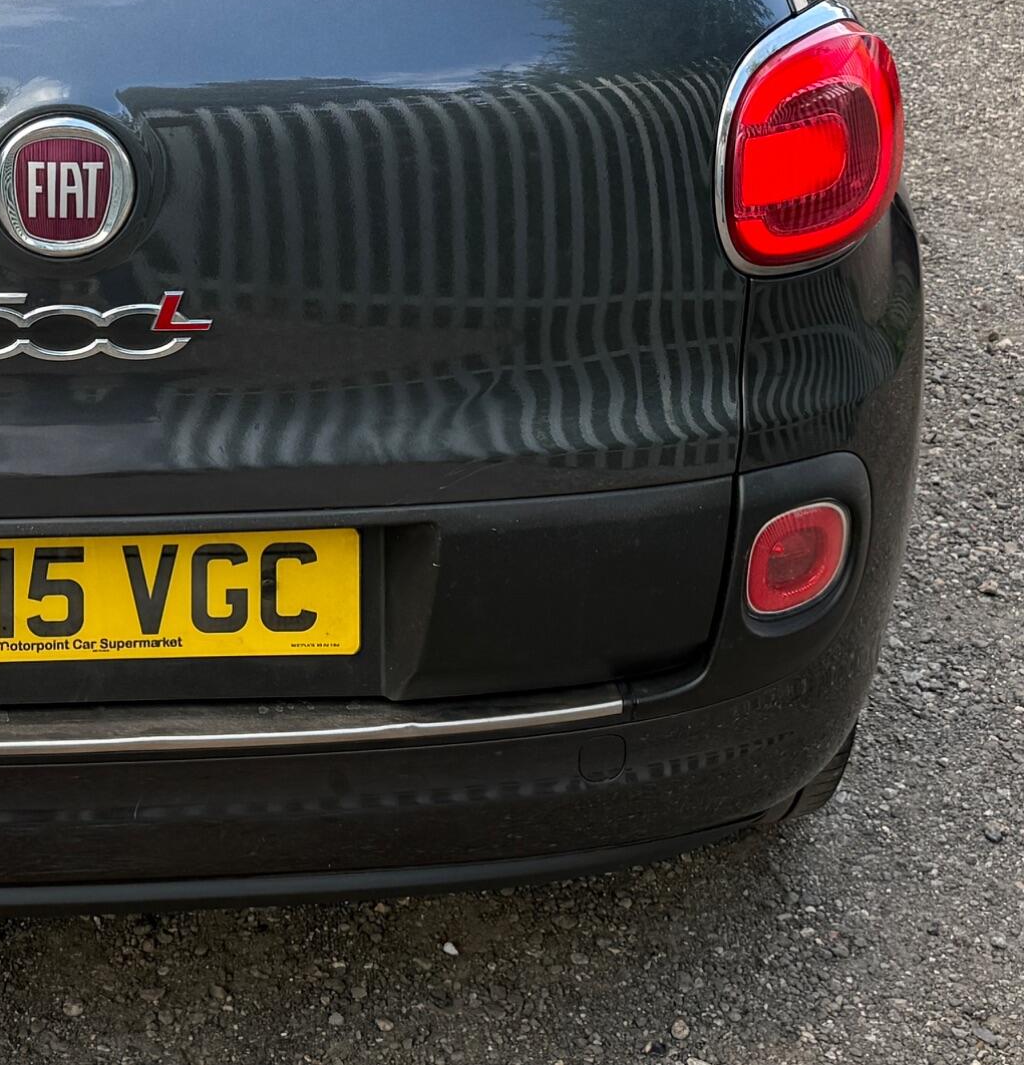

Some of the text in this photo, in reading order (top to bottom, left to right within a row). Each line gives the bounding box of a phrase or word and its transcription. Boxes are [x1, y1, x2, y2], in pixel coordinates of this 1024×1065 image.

[27, 161, 104, 218] FIAT
[122, 542, 318, 636] VGC
[72, 638, 97, 650] Car
[99, 636, 183, 652] Supermarket
